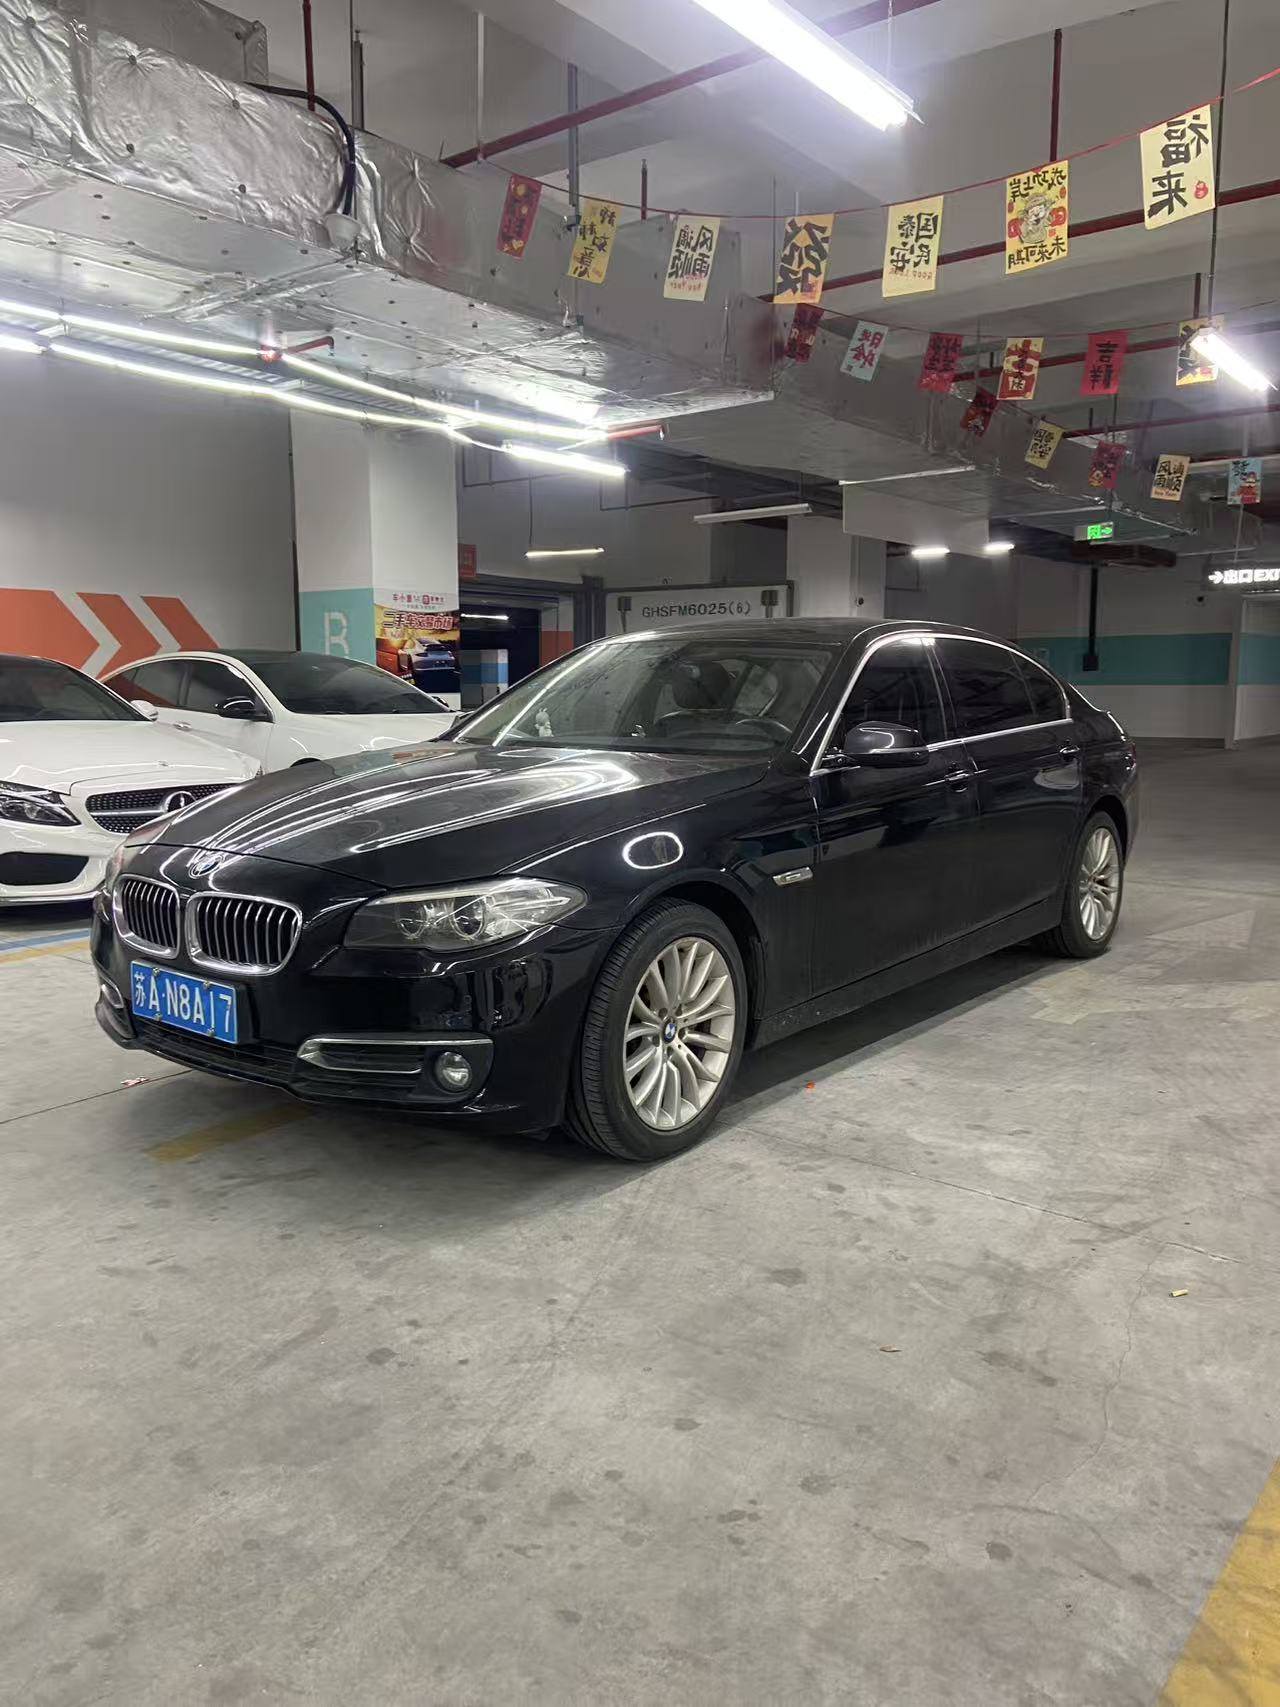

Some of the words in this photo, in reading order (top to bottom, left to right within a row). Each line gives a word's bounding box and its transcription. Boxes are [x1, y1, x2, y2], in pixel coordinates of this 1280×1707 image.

[1223, 569, 1253, 584] 出口
[1254, 568, 1280, 582] EXI
[324, 611, 350, 656] R
